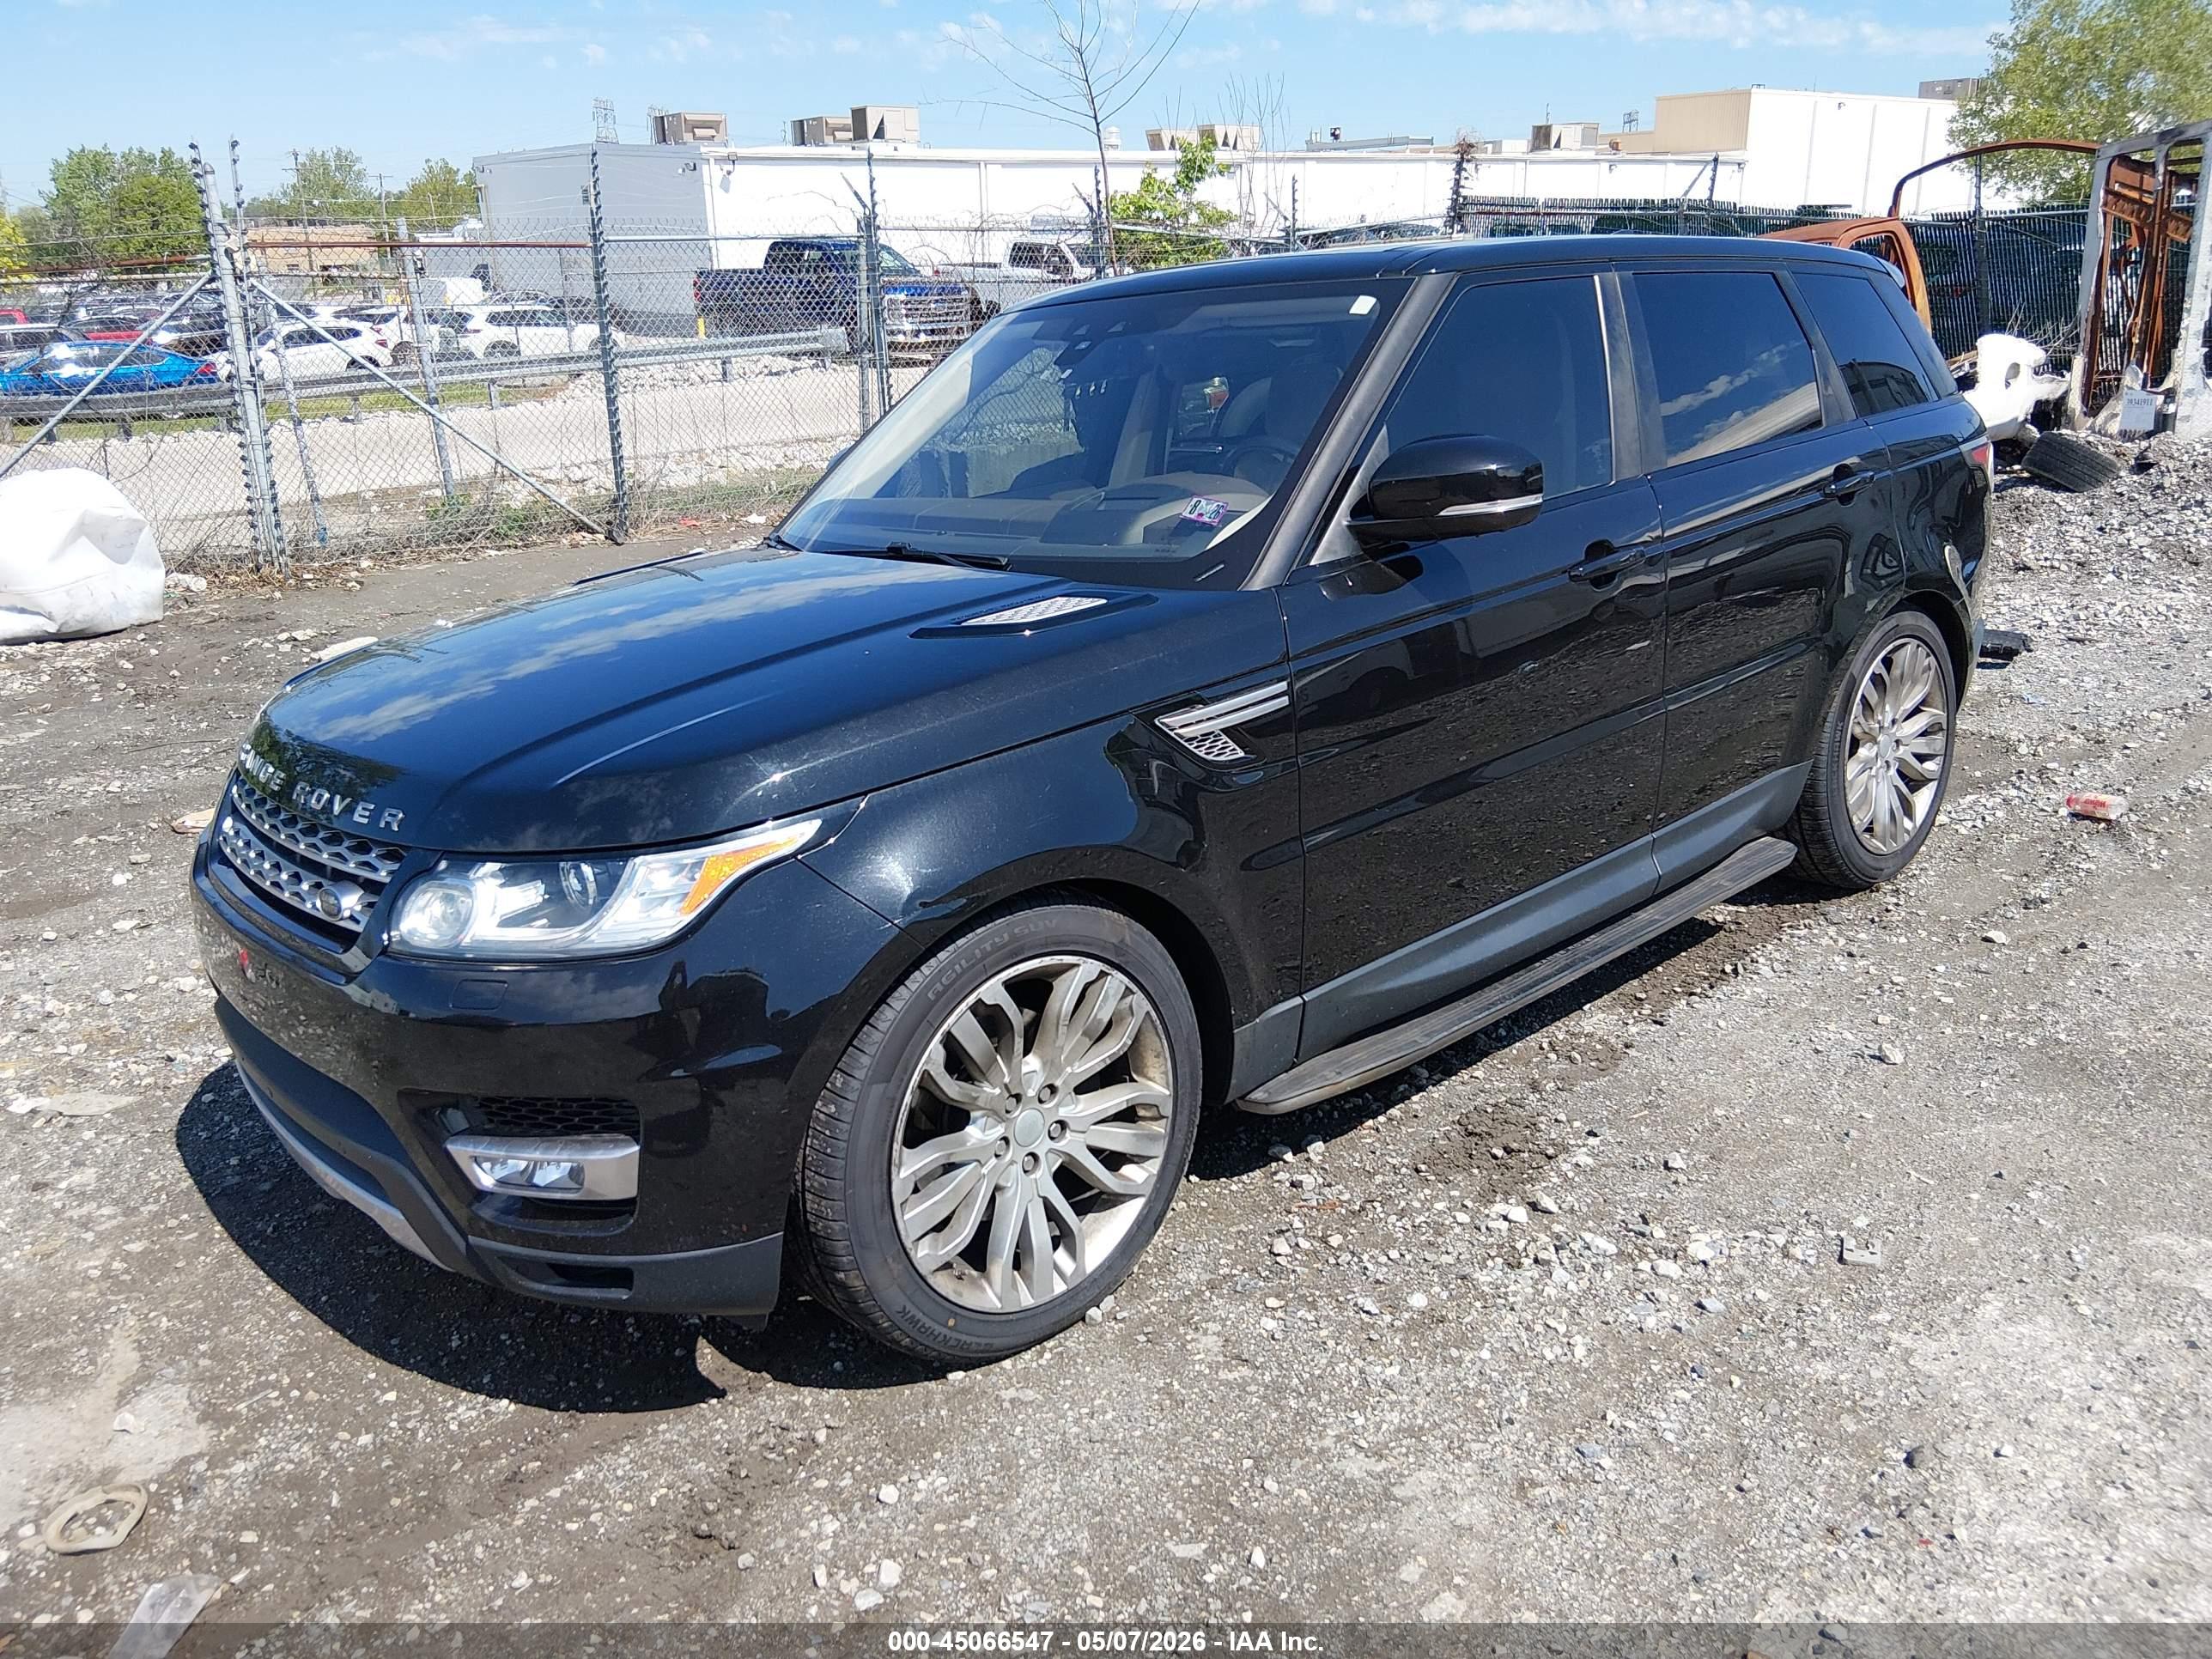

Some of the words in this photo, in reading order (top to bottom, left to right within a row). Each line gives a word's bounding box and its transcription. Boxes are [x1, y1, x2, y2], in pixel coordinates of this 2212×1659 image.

[1189, 500, 1201, 514] 8
[1832, 720, 1844, 800] ACKHAWK
[291, 781, 406, 832] ROVER
[926, 931, 1011, 1003] AGILITY
[1013, 919, 1059, 936] SUV
